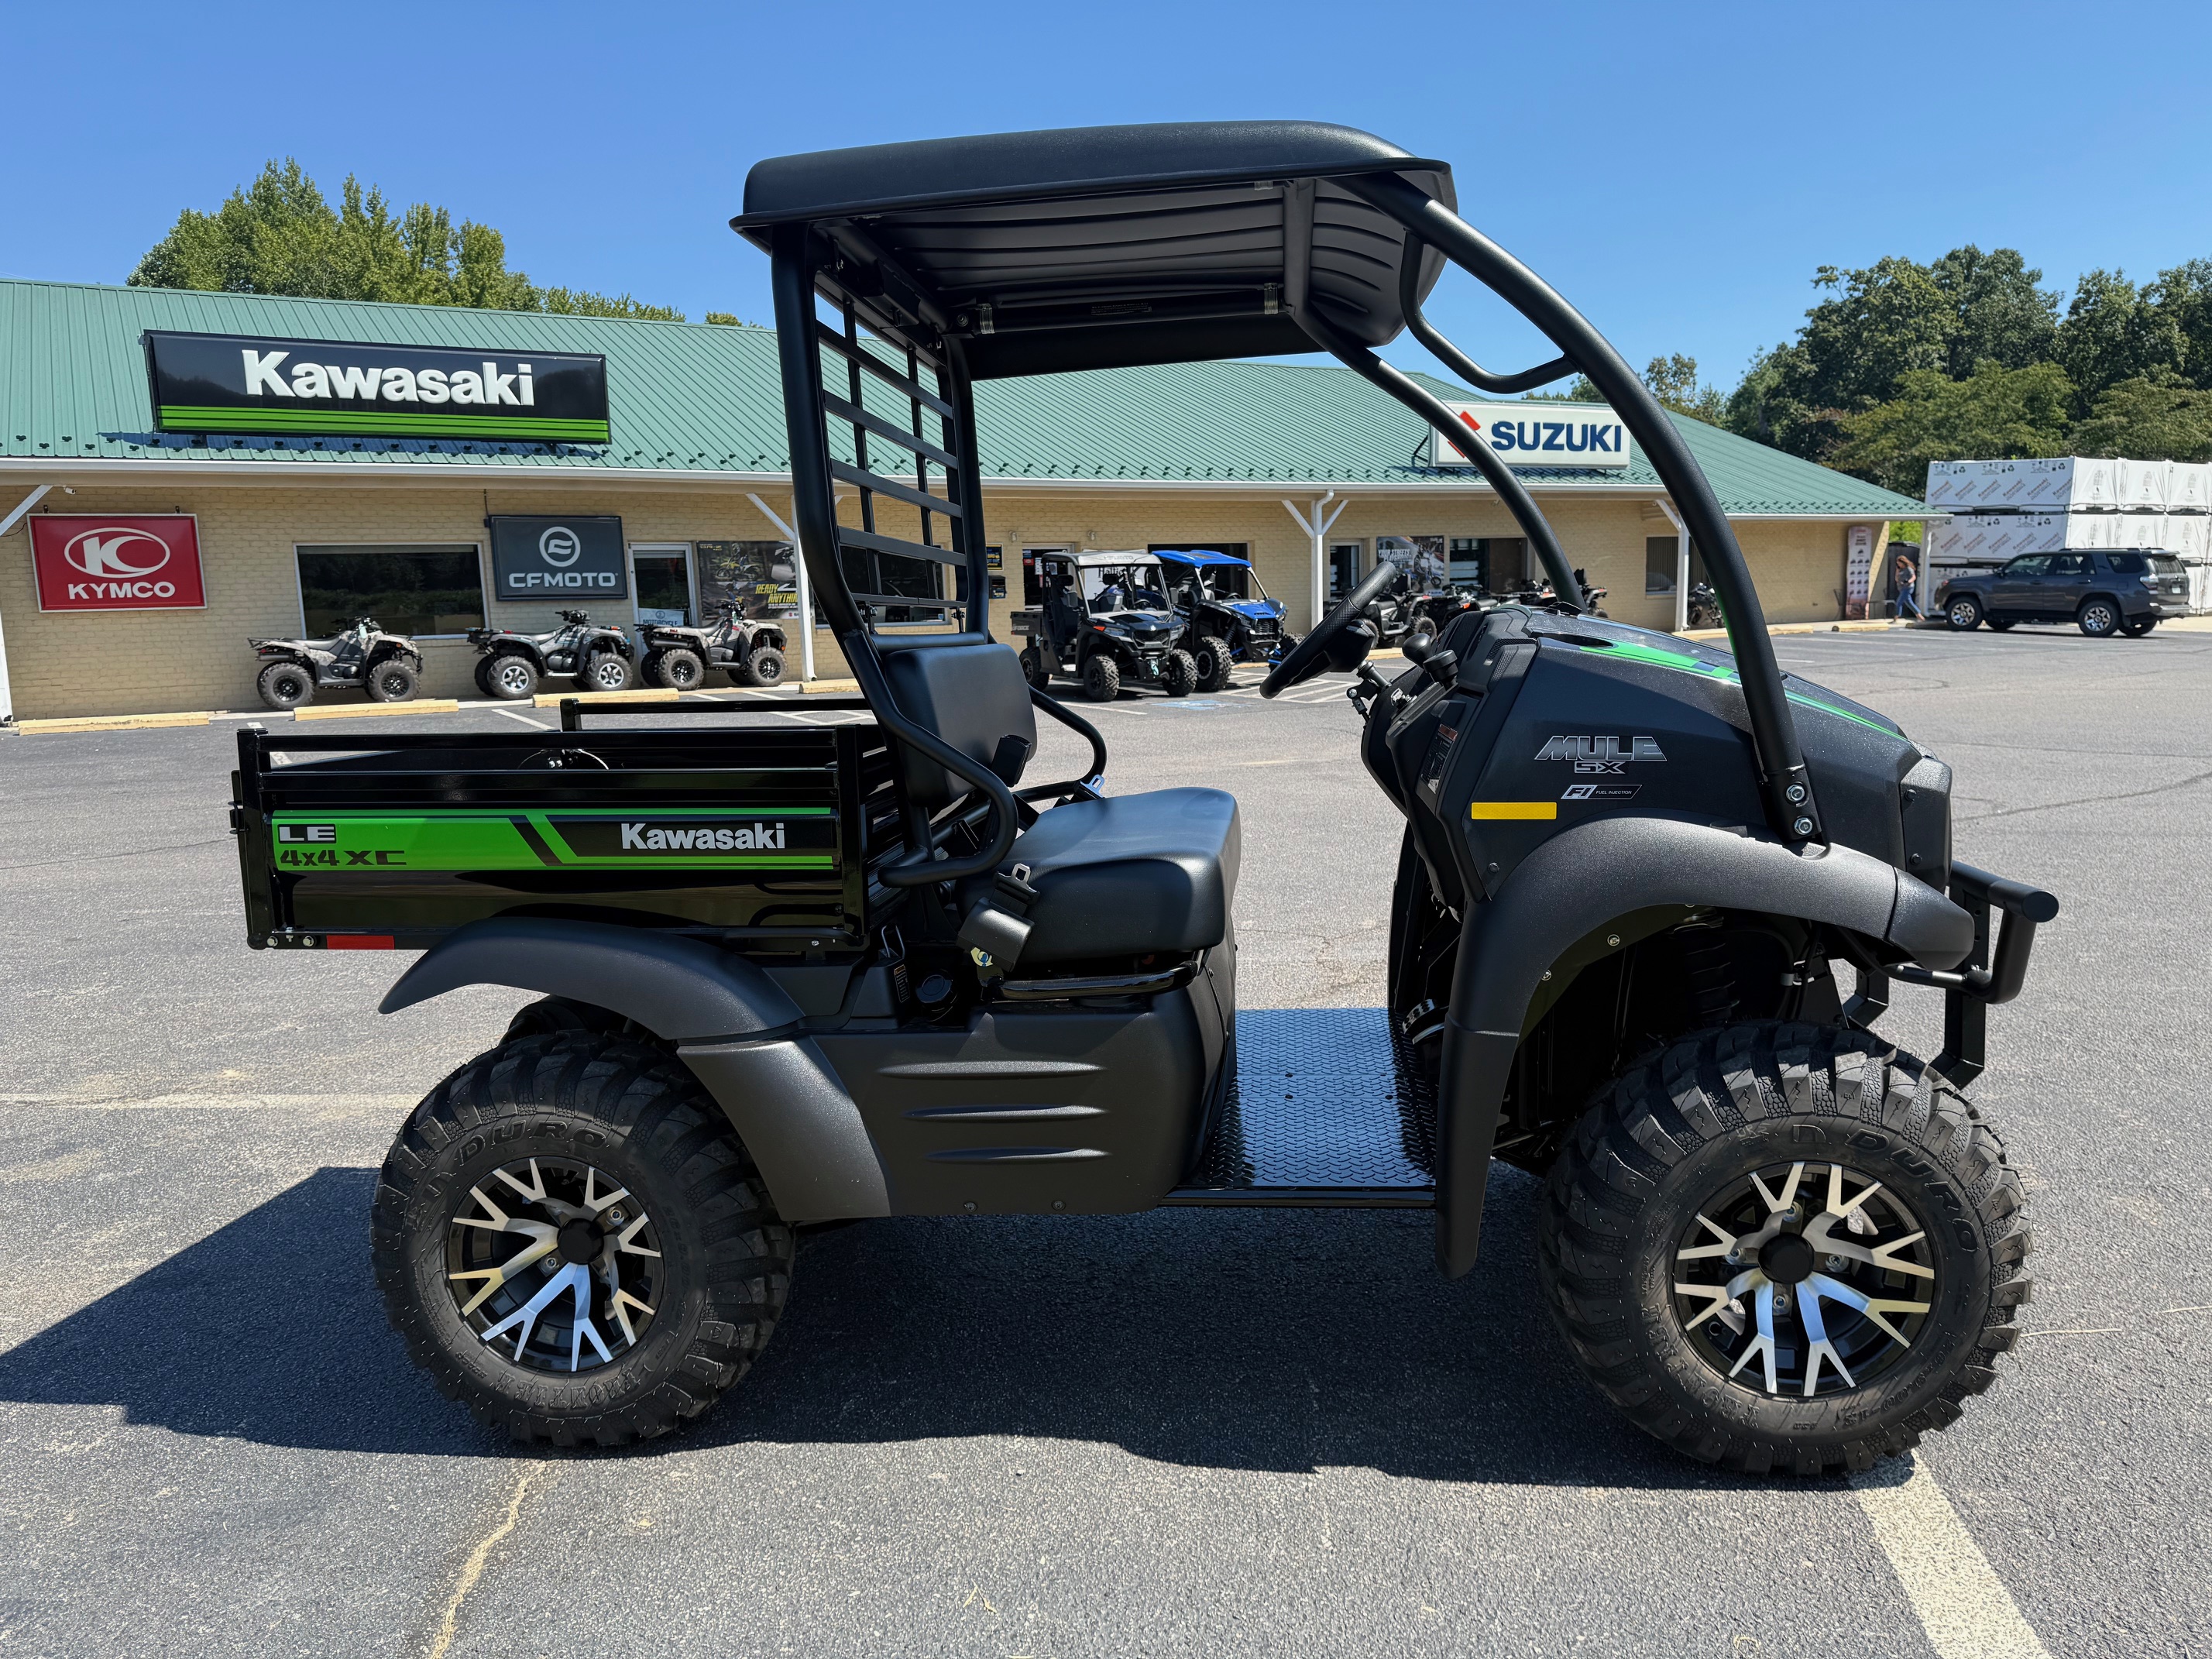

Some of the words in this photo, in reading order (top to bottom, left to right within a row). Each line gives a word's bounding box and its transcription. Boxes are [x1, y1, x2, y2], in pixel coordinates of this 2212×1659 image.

[242, 349, 535, 407] Kawasaki
[1491, 421, 1622, 452] SUZUKI
[67, 581, 176, 599] KYMCO
[508, 572, 617, 588] CFMOTO
[755, 583, 779, 594] READY
[768, 593, 799, 604] ANYTHIN
[1534, 735, 1668, 761] MULE
[1574, 761, 1626, 775] SX
[279, 826, 335, 841] LE
[620, 822, 785, 850] Kawasaki
[280, 850, 340, 867] 4x4
[343, 850, 407, 866] XC
[460, 1120, 608, 1162] DURO
[1843, 1126, 1980, 1253] DURO
[496, 1366, 642, 1410] FRONTIER
